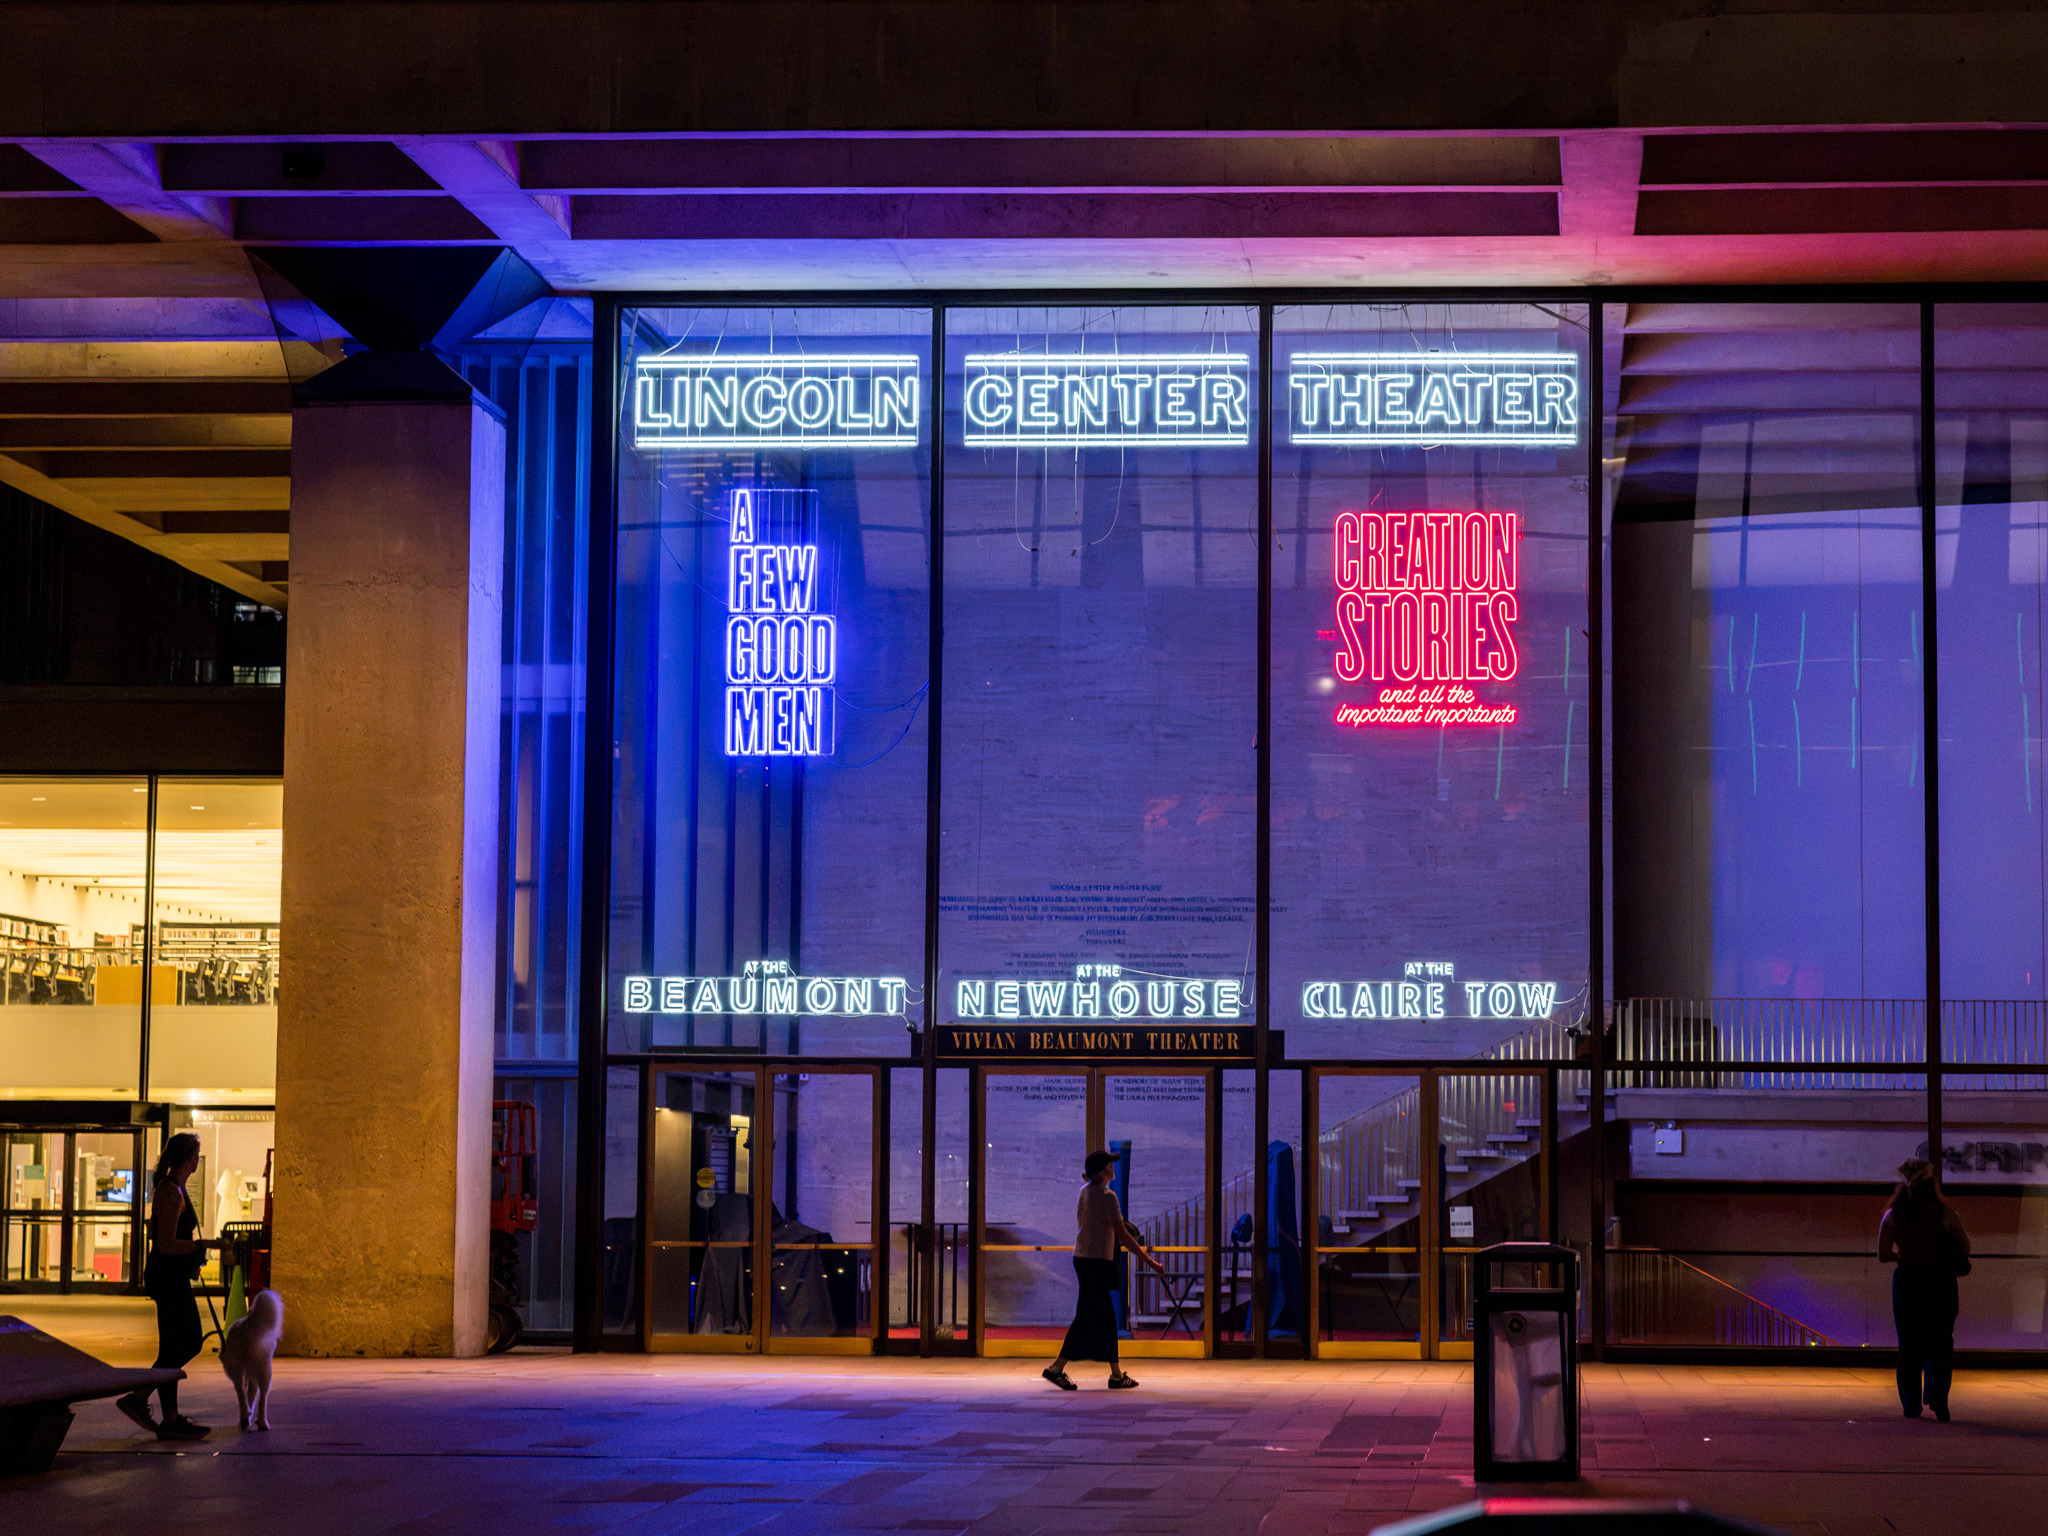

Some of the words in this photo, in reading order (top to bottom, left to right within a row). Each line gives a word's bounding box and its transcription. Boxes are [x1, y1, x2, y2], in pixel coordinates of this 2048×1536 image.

[636, 376, 918, 428] LINCOLN
[965, 374, 1247, 427] CENTER
[1290, 373, 1577, 426] THEATER
[731, 489, 754, 542] A
[1335, 512, 1518, 591] CREATION
[729, 546, 817, 613] FEW
[727, 616, 836, 684] GOOD
[1335, 592, 1519, 682] STORIES
[1379, 685, 1416, 704] and
[1418, 685, 1445, 703] all
[1448, 685, 1475, 704] the
[726, 687, 821, 755] MEN
[1336, 703, 1424, 728] important
[1424, 703, 1516, 728] importants
[744, 960, 761, 974] AT
[762, 960, 787, 974] THE
[1077, 964, 1092, 978] AT
[1095, 964, 1121, 978] THE
[1405, 963, 1425, 976] AT
[1427, 963, 1453, 976] THE
[624, 976, 905, 1015] BEAUMONT
[958, 980, 1241, 1017] NEWHOUSE
[1303, 982, 1446, 1018] CLAIRE
[1466, 982, 1557, 1018] TOW
[952, 1031, 1017, 1050] VIVIAN
[1029, 1031, 1134, 1050] BEAUMONT
[1147, 1031, 1241, 1050] THEATER
